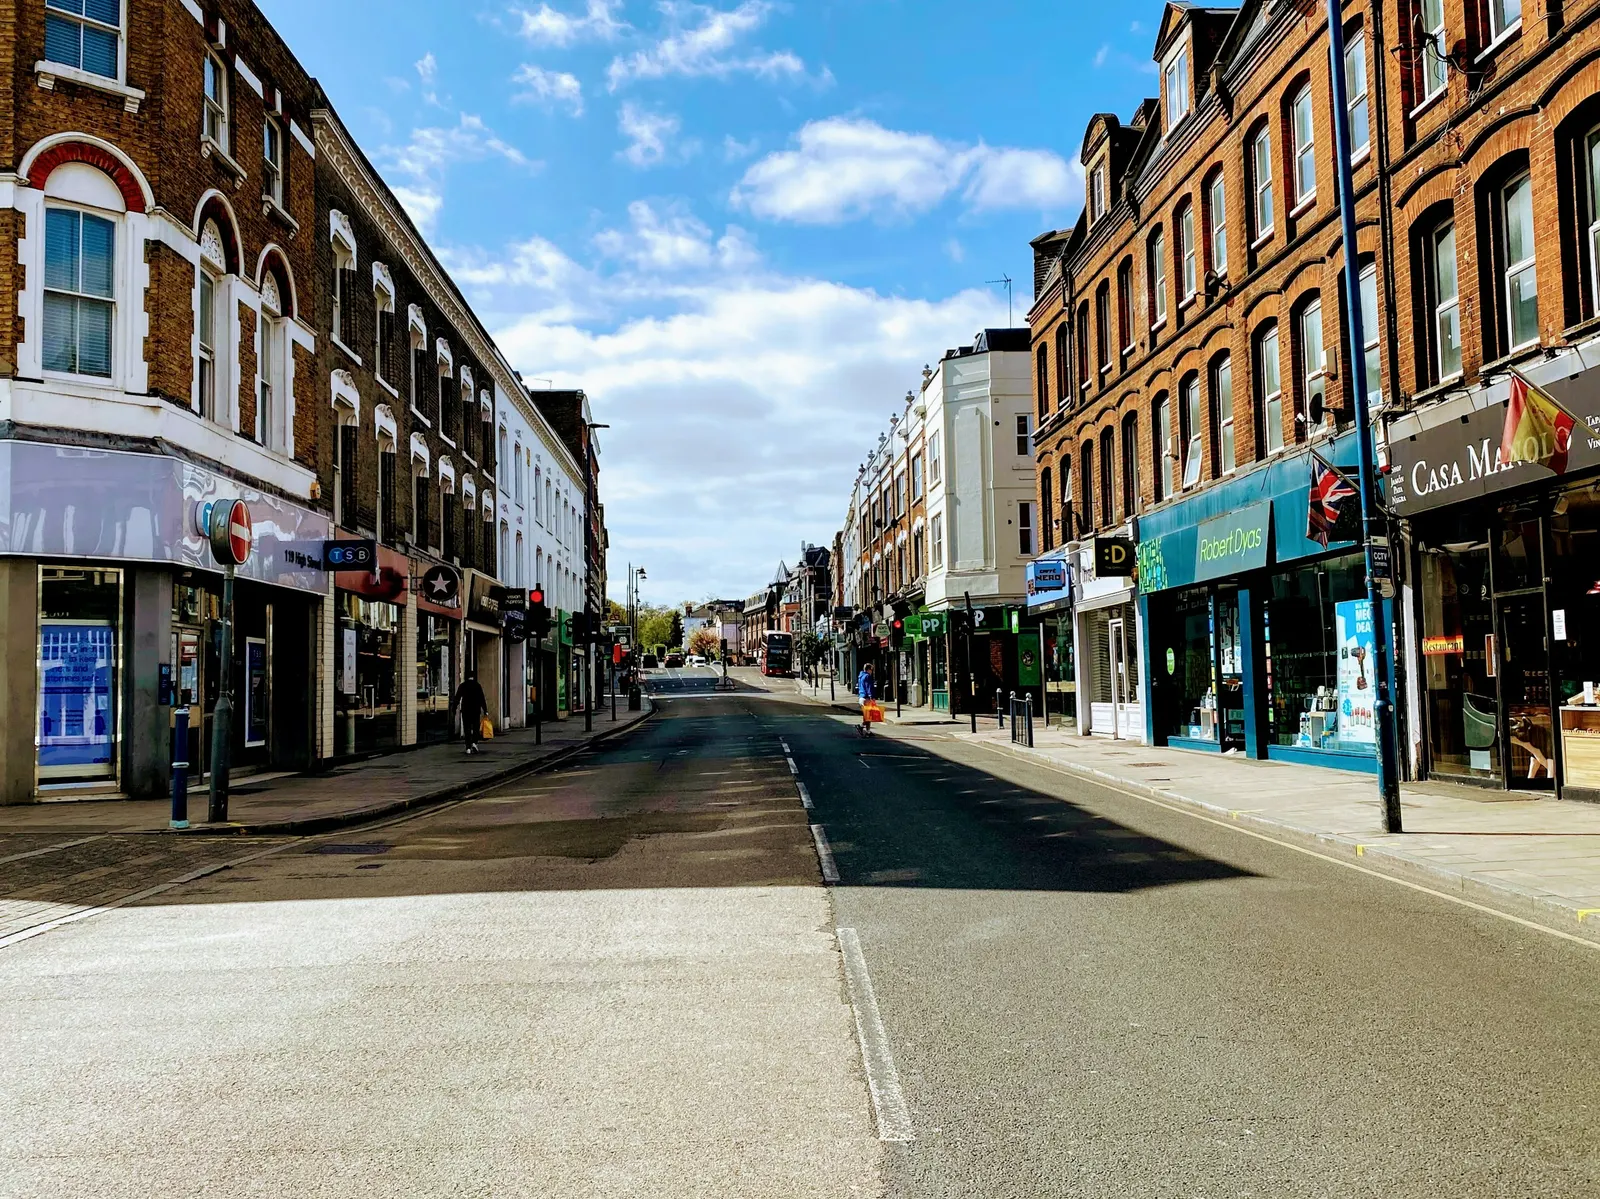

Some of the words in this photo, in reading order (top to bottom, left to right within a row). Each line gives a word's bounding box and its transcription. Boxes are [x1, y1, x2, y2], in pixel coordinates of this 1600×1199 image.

[1587, 438, 1600, 449] VIN
[1412, 460, 1464, 496] CASA
[1200, 530, 1233, 562] Robert
[1235, 528, 1262, 557] Dyas
[332, 550, 367, 561] TSB
[1373, 552, 1388, 560] CCTV
[922, 618, 940, 633] PP
[1356, 621, 1372, 633] DEA
[1424, 640, 1462, 652] Restaurant
